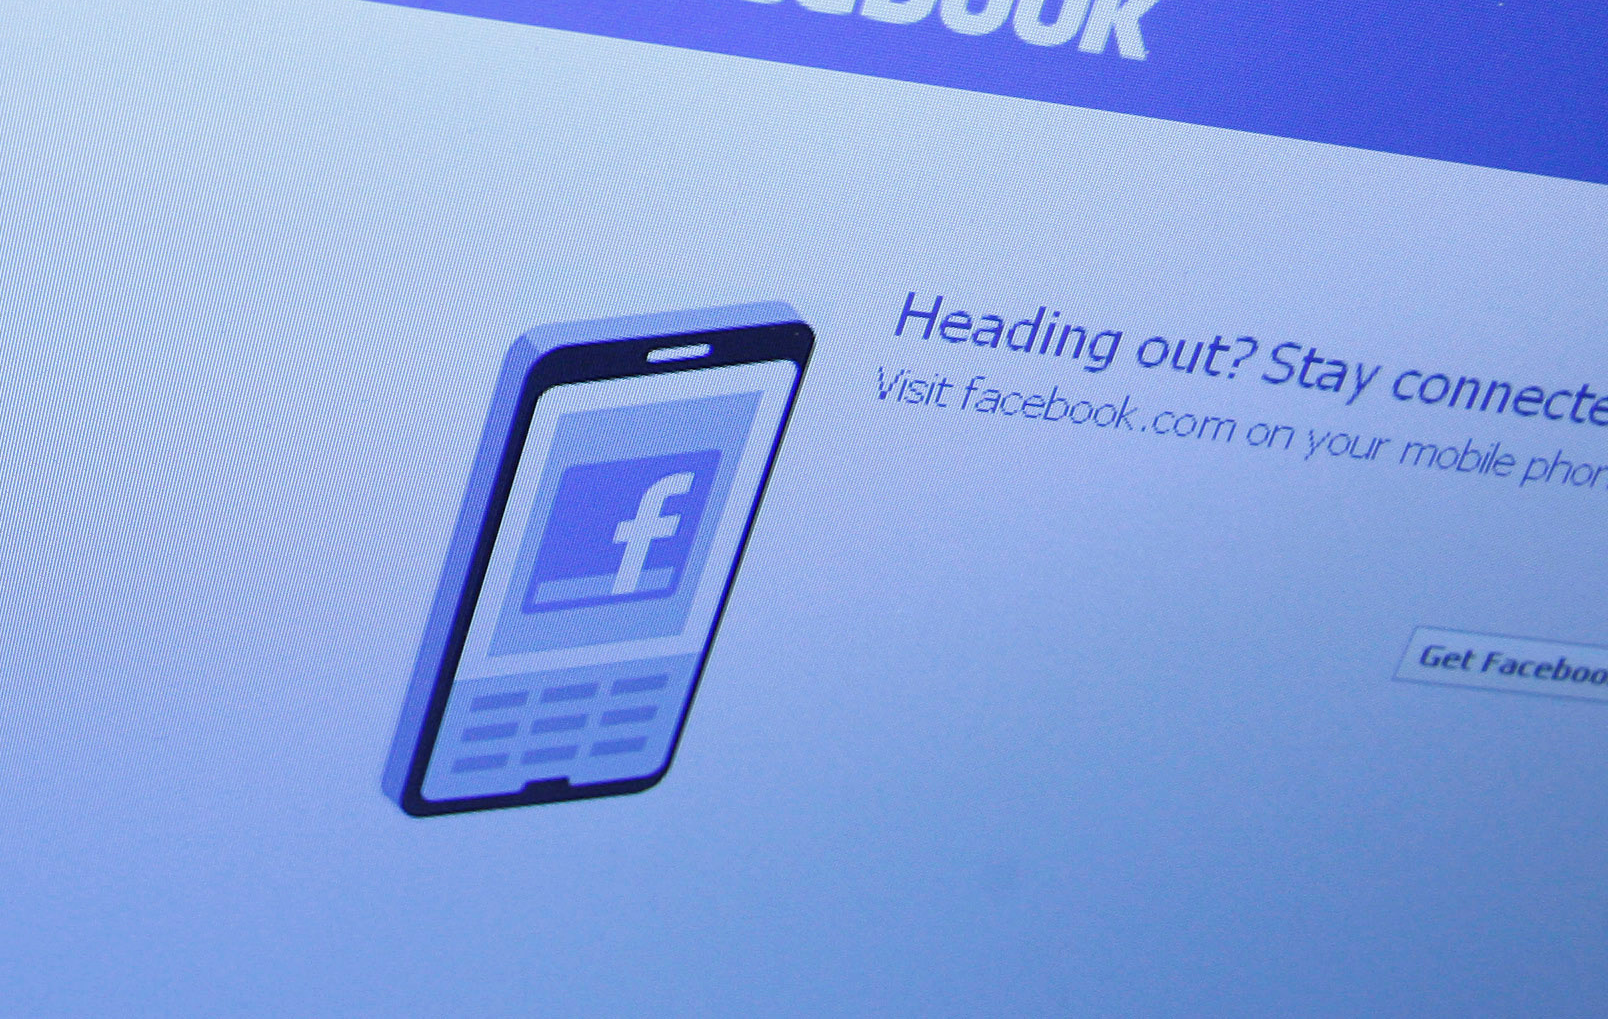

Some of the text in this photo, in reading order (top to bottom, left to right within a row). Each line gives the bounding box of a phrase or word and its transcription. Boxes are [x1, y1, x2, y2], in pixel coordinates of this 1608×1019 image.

[894, 291, 1124, 373] Heading
[1136, 334, 1259, 380] out?
[1261, 341, 1382, 405] Stay
[876, 365, 959, 410] Visit
[959, 375, 1238, 443] facebook.com
[1245, 421, 1296, 450] on
[1302, 427, 1392, 461] your
[1399, 437, 1517, 477] mobile
[612, 471, 697, 595] f
[1419, 643, 1475, 672] Get
